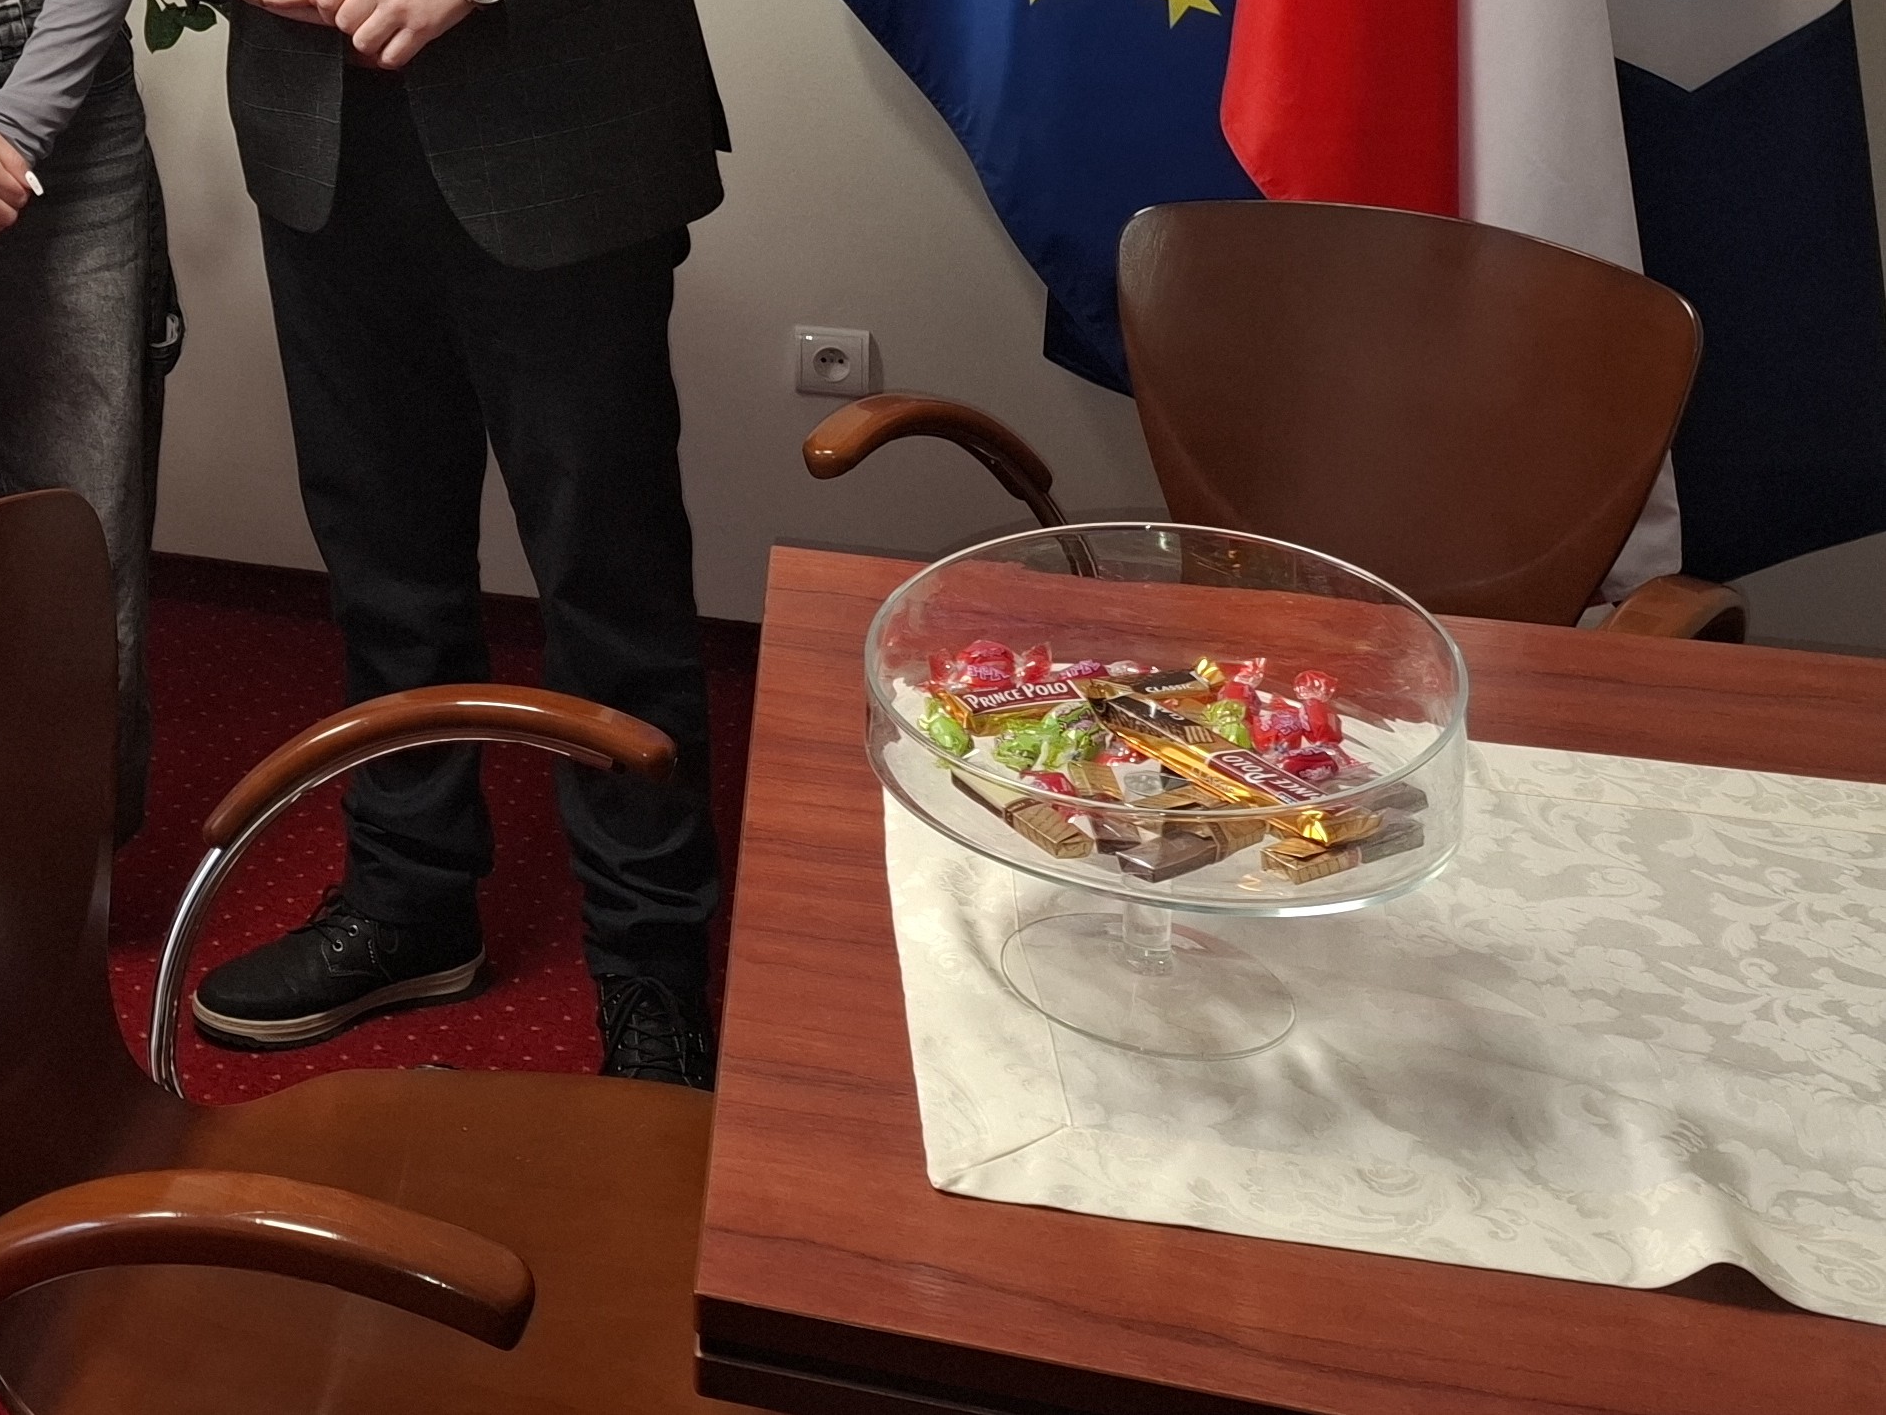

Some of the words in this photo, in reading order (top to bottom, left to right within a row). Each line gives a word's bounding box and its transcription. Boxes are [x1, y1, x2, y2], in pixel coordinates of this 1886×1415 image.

[965, 689, 1022, 710] PRINCE
[1020, 682, 1069, 698] POLO
[1144, 682, 1195, 693] CLASSIC
[1221, 754, 1274, 783] POLO
